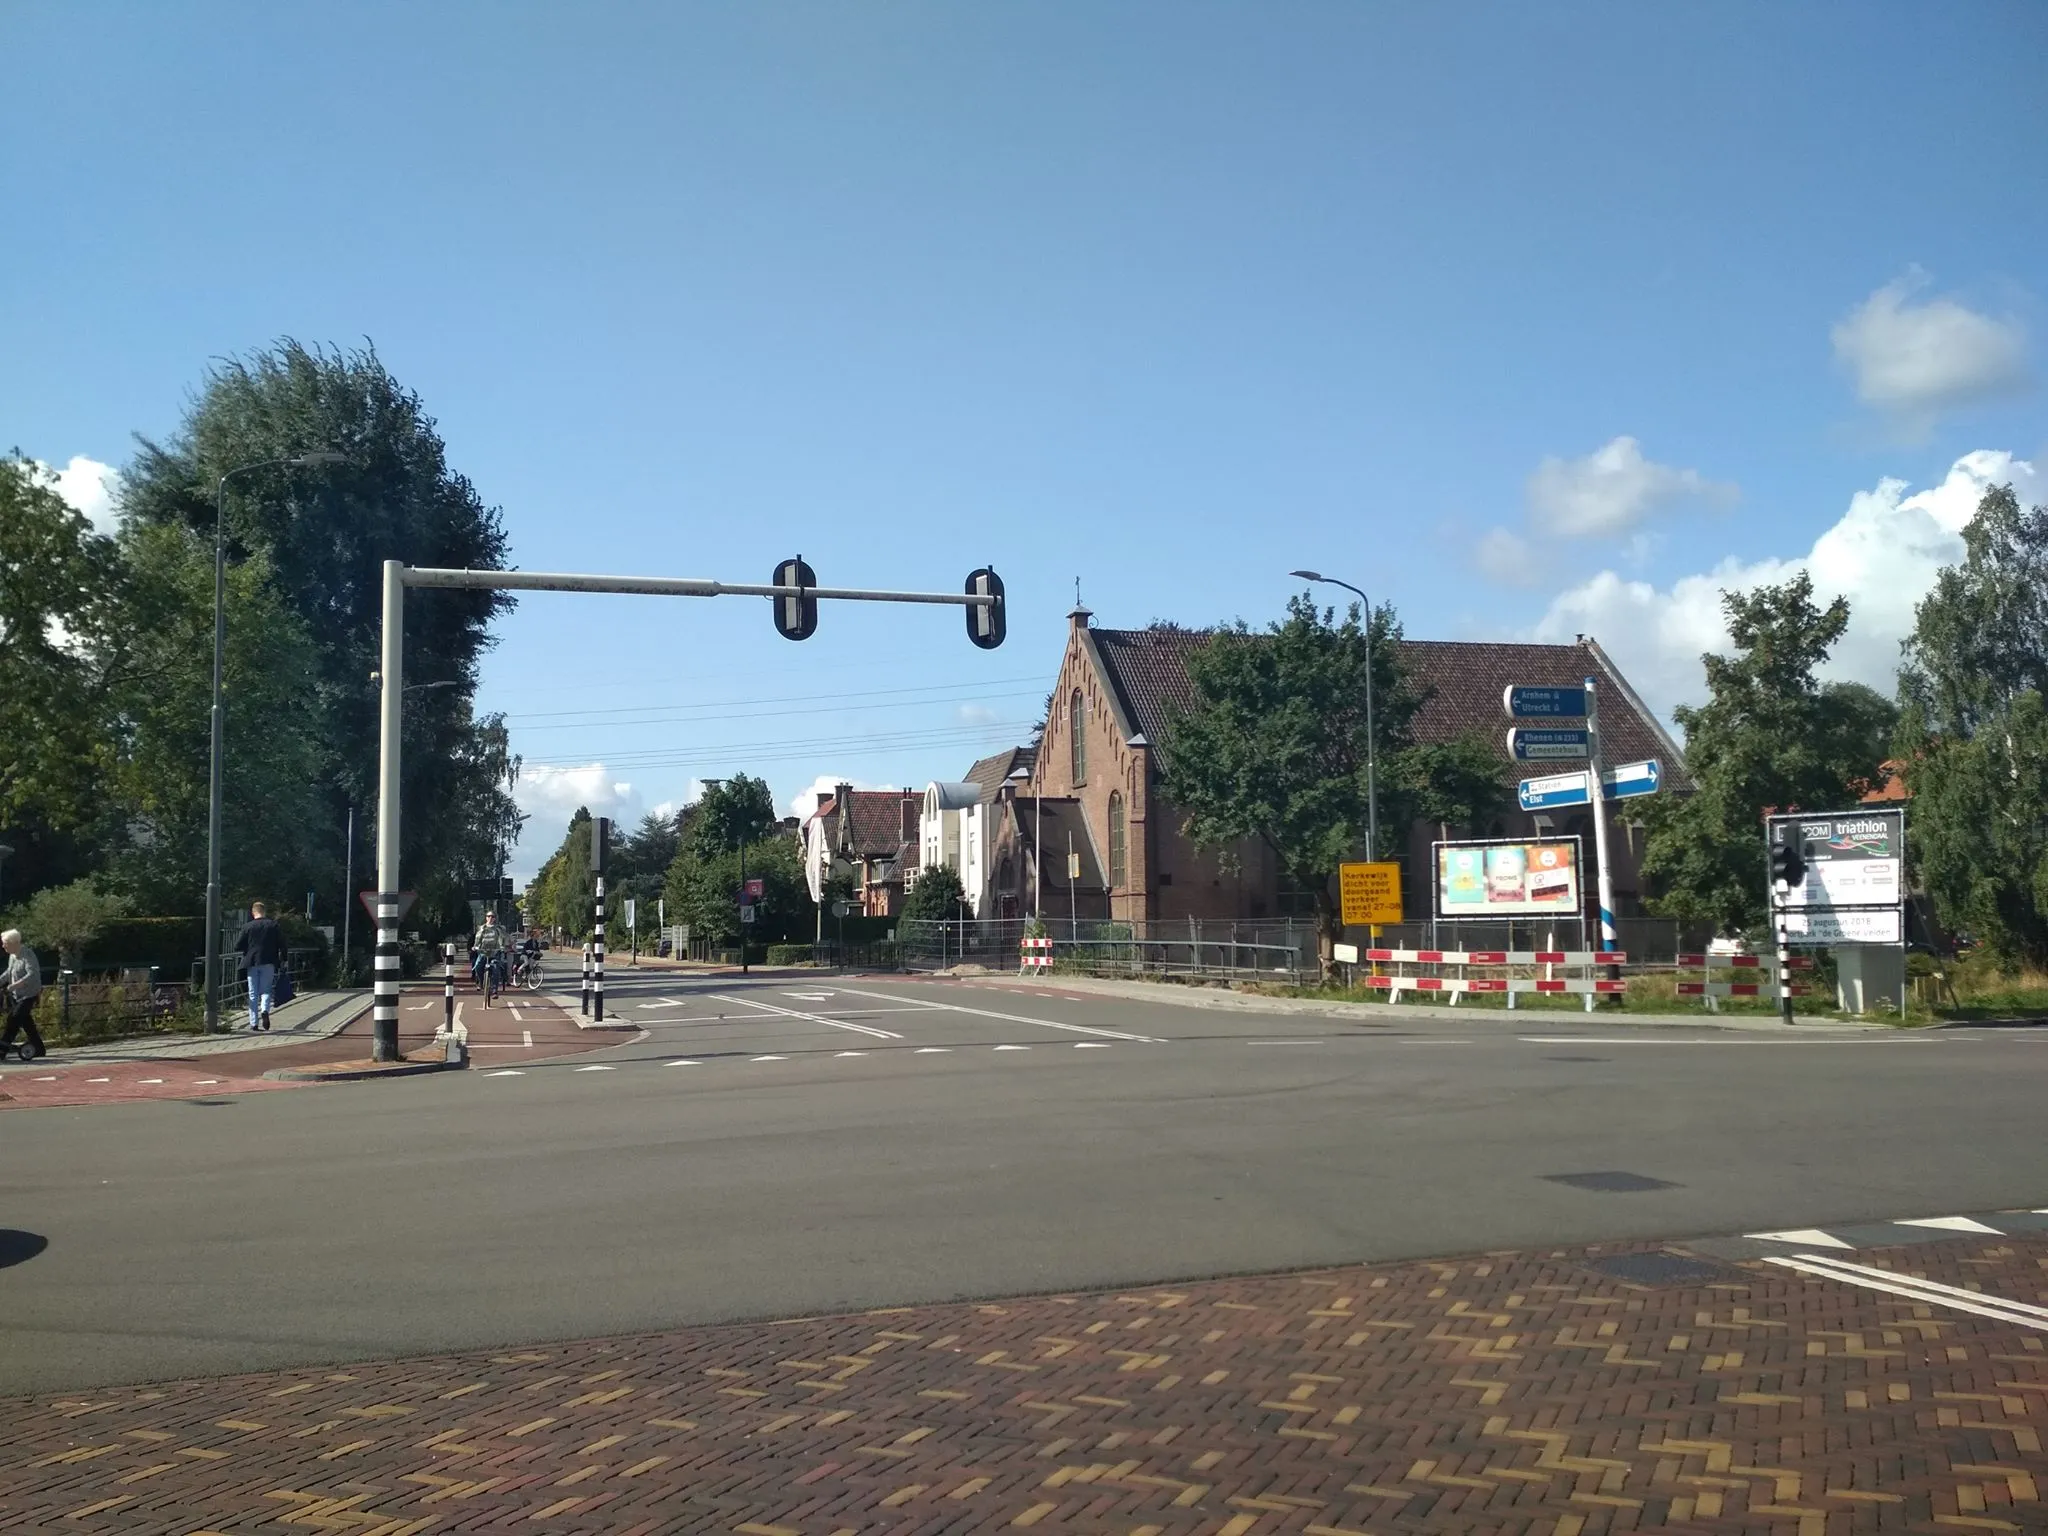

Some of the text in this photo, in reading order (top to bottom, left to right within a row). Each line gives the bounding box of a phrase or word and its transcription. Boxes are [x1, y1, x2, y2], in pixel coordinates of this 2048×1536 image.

[1521, 691, 1551, 699] Arnhem
[1521, 703, 1551, 712] Utrecht
[1524, 733, 1553, 742] Rhenen
[1527, 746, 1579, 754] Gemeentehuis
[1529, 795, 1543, 803] Elst
[1836, 821, 1887, 834] triathlon
[1852, 833, 1888, 841] VEENENDAAL
[1345, 872, 1388, 880] Kerkewijk
[1788, 928, 1817, 938] ortpark
